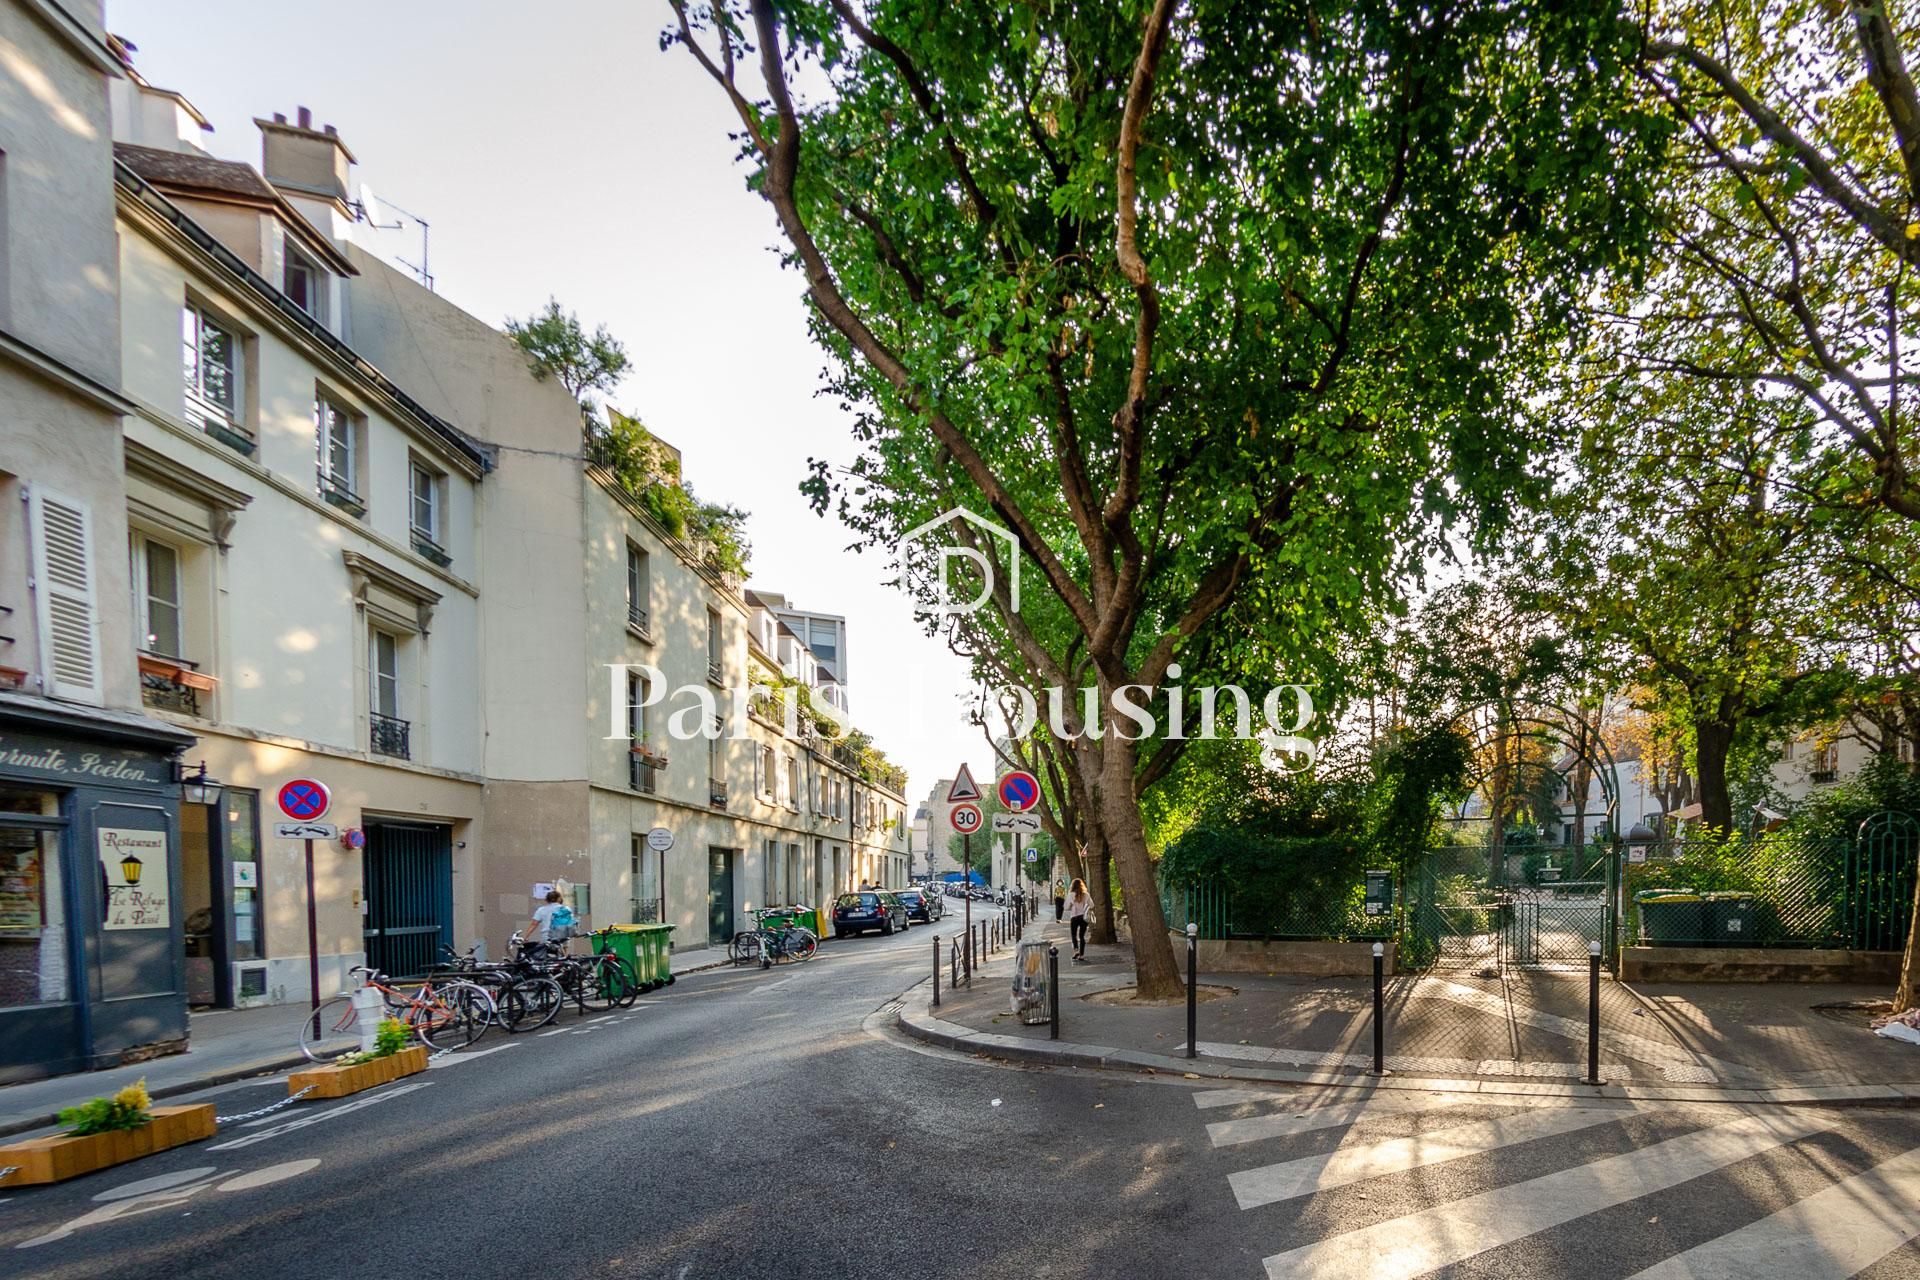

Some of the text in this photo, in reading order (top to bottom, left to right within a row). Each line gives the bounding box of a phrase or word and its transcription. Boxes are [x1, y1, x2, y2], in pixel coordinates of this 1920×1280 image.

[0, 737, 69, 774] armite,
[957, 811, 976, 825] 30
[103, 832, 162, 855] Restaurant
[112, 892, 167, 913] Le Refuge
[112, 910, 126, 925] du
